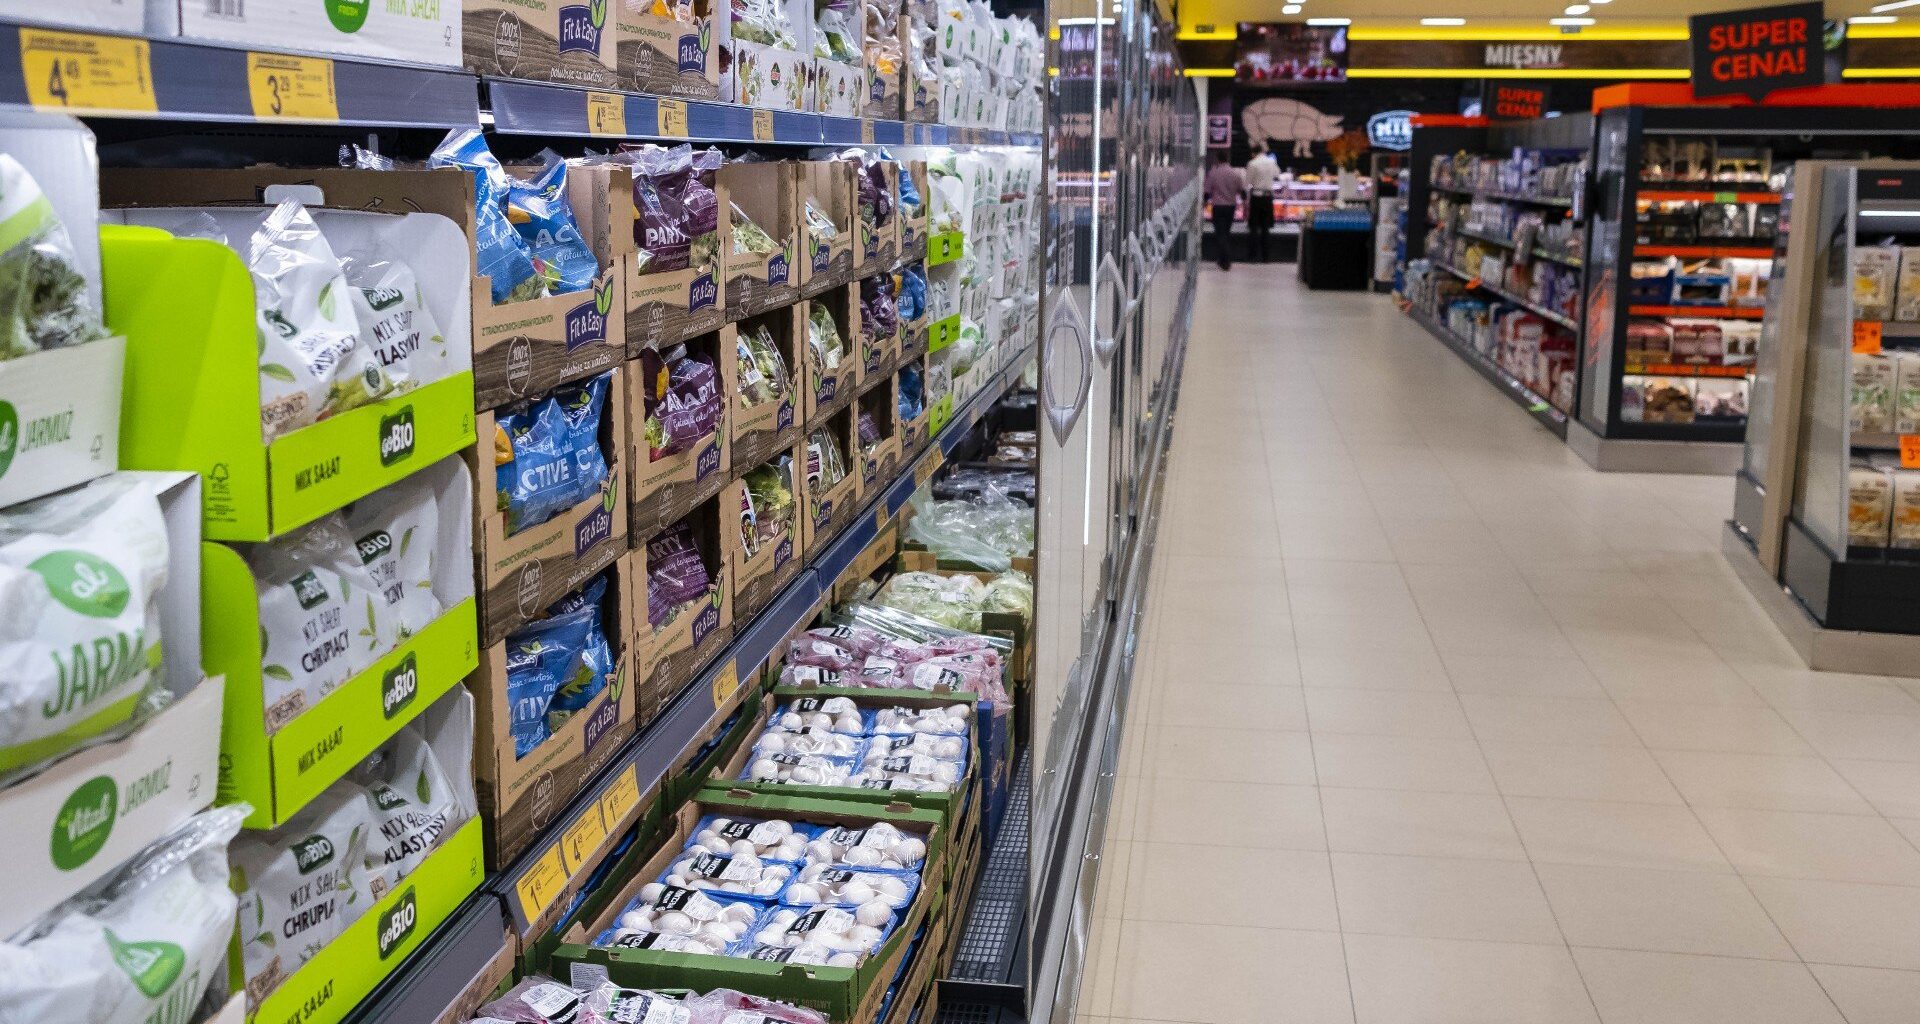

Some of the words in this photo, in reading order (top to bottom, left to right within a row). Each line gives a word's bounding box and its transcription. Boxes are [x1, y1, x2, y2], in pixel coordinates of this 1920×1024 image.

[564, 18, 575, 42] Fit
[575, 19, 580, 38] &
[582, 16, 598, 50] Easy
[1708, 17, 1808, 51] SUPER
[1485, 44, 1562, 68] MIĘSNY
[1711, 47, 1806, 81] CENA!
[49, 57, 67, 106] 4
[267, 75, 281, 115] 3
[1497, 86, 1544, 103] SUPER
[1496, 102, 1541, 119] CENA!
[645, 225, 688, 247] PARTY
[372, 318, 393, 344] MIX
[570, 316, 581, 343] Fit
[581, 315, 587, 334] &
[588, 310, 604, 337] Easy
[381, 421, 414, 458] goBIO
[295, 467, 313, 491] MIX
[314, 456, 341, 484] SAŁAT
[521, 457, 570, 492] CTIVE
[580, 525, 590, 550] Fit
[596, 511, 610, 536] Easy
[706, 609, 718, 630] Easy
[384, 667, 416, 712] goBIO
[587, 722, 597, 746] Fit
[603, 702, 617, 727] Easy
[298, 753, 316, 777] MIX
[316, 725, 344, 758] SAŁAT
[380, 819, 404, 841] MIX
[573, 838, 582, 863] 4
[290, 884, 312, 911] MIX
[530, 885, 541, 911] 1
[380, 901, 415, 952] goBIO
[303, 979, 335, 1021] SAŁAT
